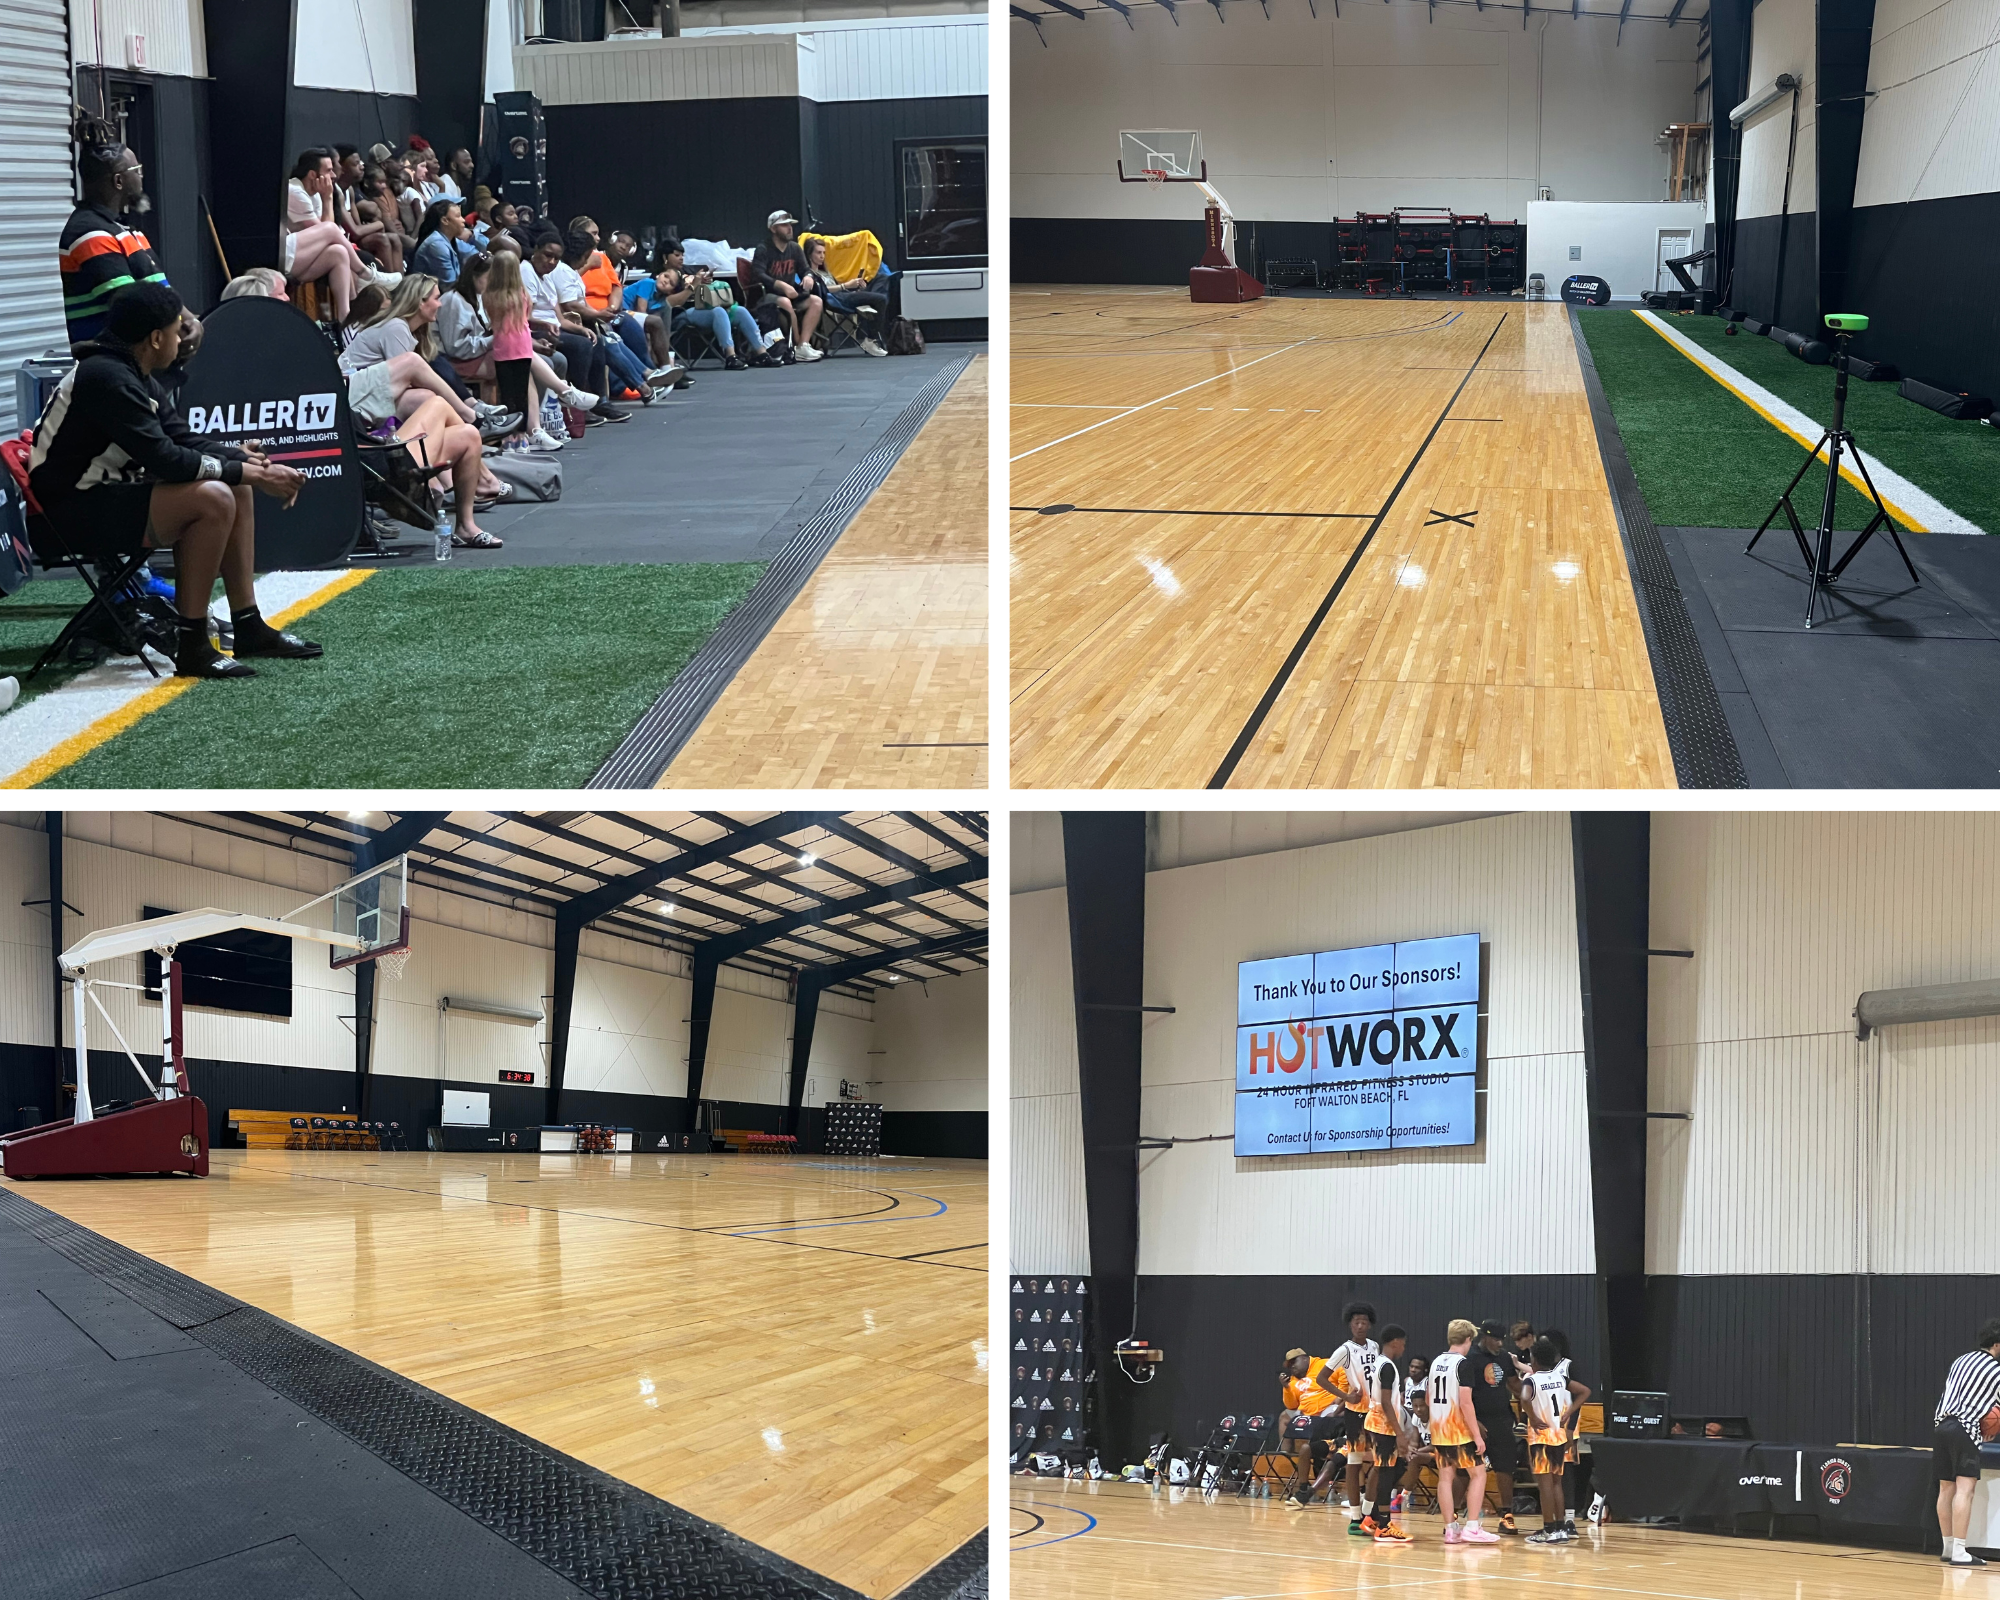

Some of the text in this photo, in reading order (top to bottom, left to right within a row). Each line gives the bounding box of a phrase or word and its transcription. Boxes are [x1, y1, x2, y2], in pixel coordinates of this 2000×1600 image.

[243, 436, 278, 447] RAYS,
[279, 435, 295, 445] AND
[296, 432, 339, 443] HIGHLIGHTS
[297, 464, 342, 479] V.COM
[1254, 962, 1461, 1001] Thank You to Our Sponsors!
[1305, 1080, 1357, 1095] IFRARED
[1408, 1072, 1450, 1086] STUDIO
[1318, 1094, 1358, 1107] WALTON
[1398, 1090, 1409, 1102] FL
[1267, 1132, 1301, 1144] Contact
[1314, 1130, 1327, 1141] for
[1328, 1126, 1384, 1142] Sponsorship
[1433, 1375, 1448, 1404] 11
[1551, 1393, 1560, 1417] 1
[1643, 1417, 1660, 1425] GUEST
[1176, 1465, 1184, 1478] 4
[1739, 1475, 1783, 1486] overme
